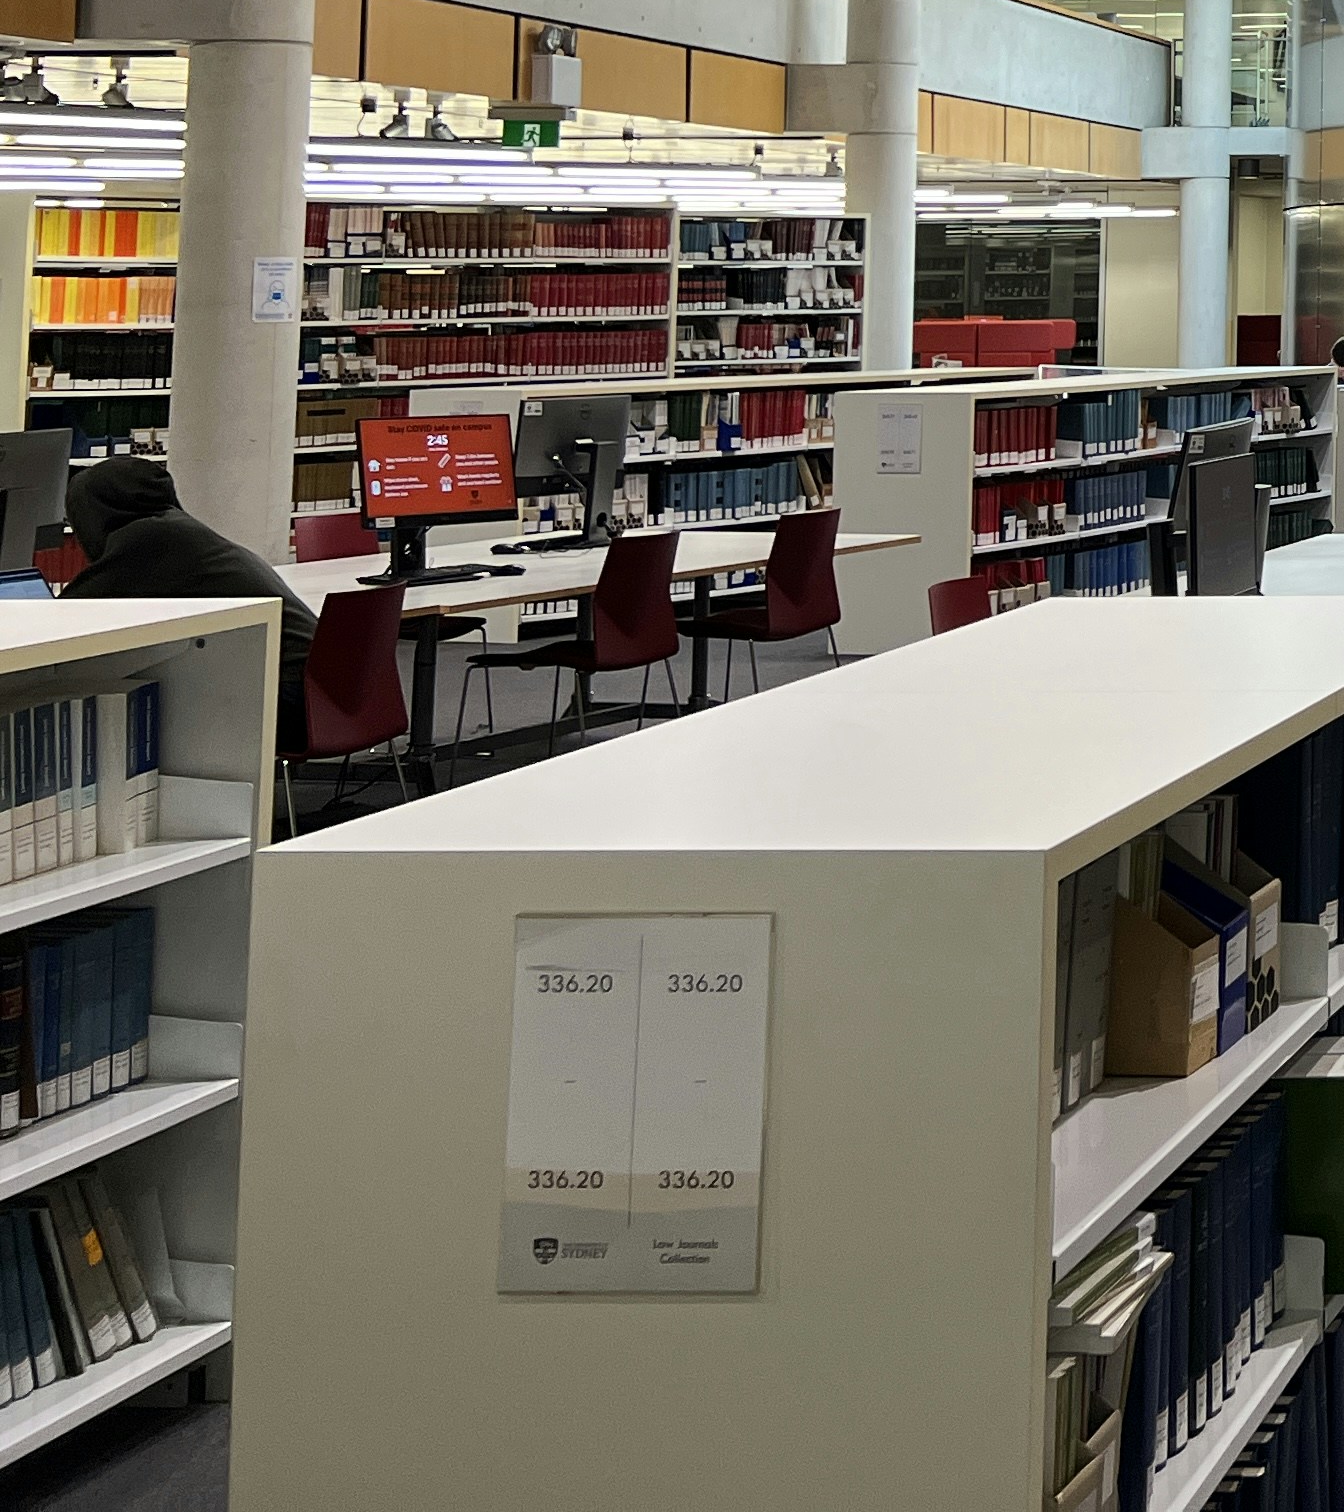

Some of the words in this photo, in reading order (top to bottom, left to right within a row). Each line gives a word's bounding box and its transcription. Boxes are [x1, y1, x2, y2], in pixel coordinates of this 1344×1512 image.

[406, 424, 432, 433] COVID
[426, 434, 448, 446] 2:45
[537, 973, 613, 993] 336.20
[667, 973, 743, 993] 336.20
[528, 1170, 604, 1189] 336.20
[658, 1170, 735, 1190] 336.20
[652, 1239, 674, 1250] Law
[561, 1246, 608, 1259] SYDNEY
[659, 1252, 711, 1265] Collection
